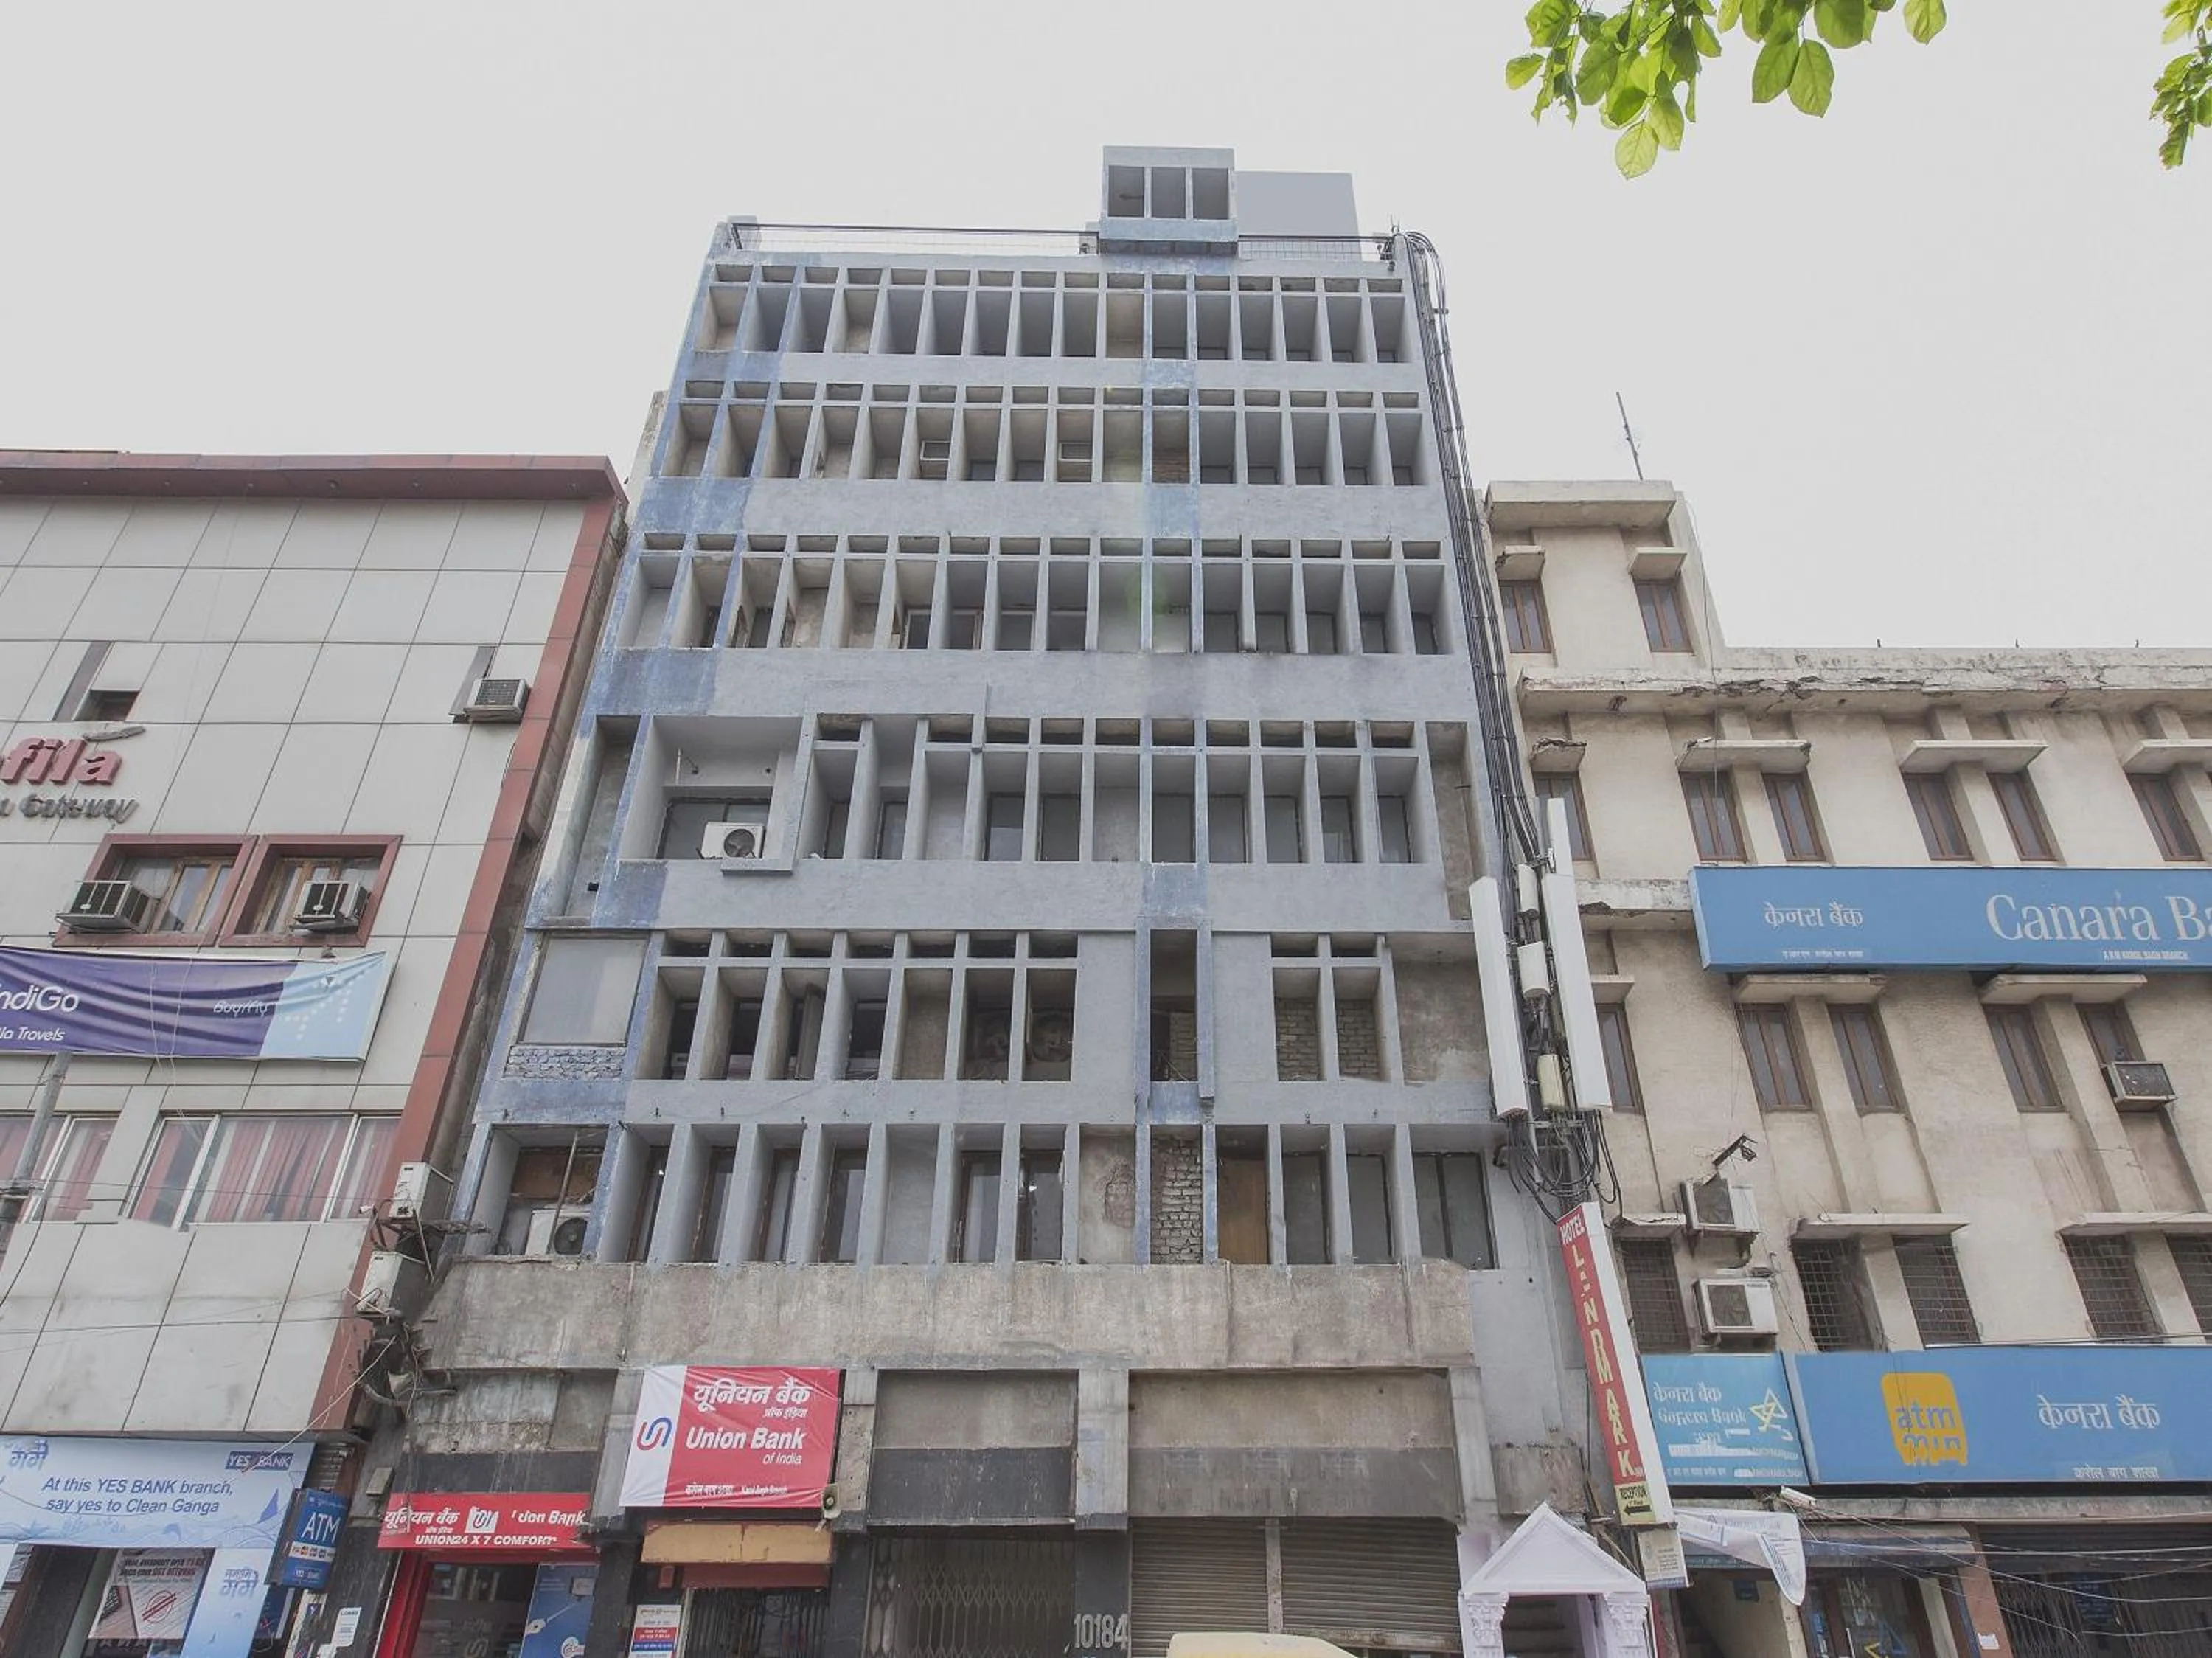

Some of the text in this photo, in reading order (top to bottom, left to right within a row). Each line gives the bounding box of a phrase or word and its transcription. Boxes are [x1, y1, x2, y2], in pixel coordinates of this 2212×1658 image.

[0, 736, 122, 785] fila
[1763, 901, 1864, 927] केनरा बैंक
[1986, 894, 2212, 941] Canara B
[0, 984, 79, 1012] ndiGo
[18, 1027, 66, 1041] Travels
[1559, 1213, 1585, 1246] HOTEL
[694, 1376, 813, 1412] यूनियन बैंक
[1895, 1401, 1956, 1429] atm
[2037, 1394, 2161, 1429] केनरा बैंक
[686, 1427, 806, 1449] Union Bank
[229, 1454, 291, 1468] YES BANK
[762, 1453, 802, 1464] of India
[42, 1477, 233, 1496] At this YES BANK branch,
[46, 1498, 220, 1516] say yes to Clean Ganga
[548, 1510, 588, 1527] Bank
[300, 1512, 341, 1544] ATM
[470, 1536, 480, 1545] X
[484, 1536, 491, 1545] 7
[1073, 1613, 1128, 1651] 10184
